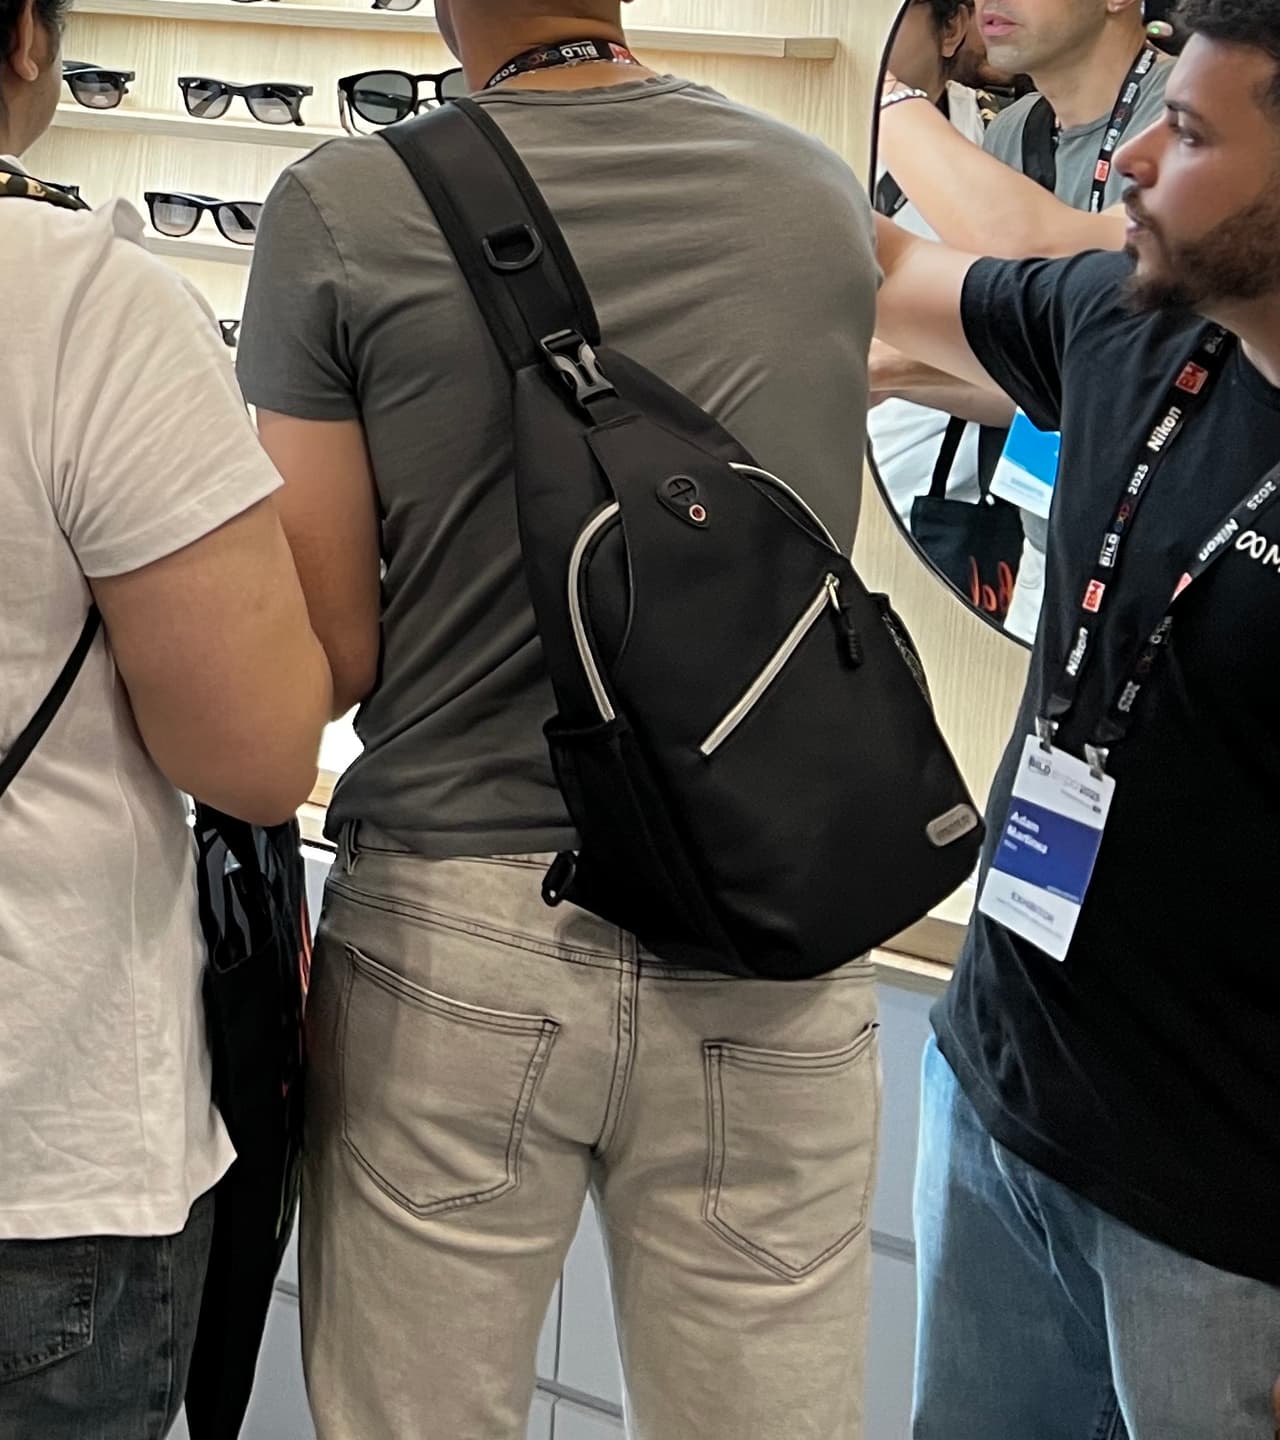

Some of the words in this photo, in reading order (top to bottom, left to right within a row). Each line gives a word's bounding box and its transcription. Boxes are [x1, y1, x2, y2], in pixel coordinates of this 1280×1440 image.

[1147, 405, 1182, 452] Nikon
[1246, 480, 1277, 511] 2025
[1198, 518, 1239, 562] Nikon
[1066, 626, 1089, 676] Nikon
[1128, 464, 1149, 495] 2025
